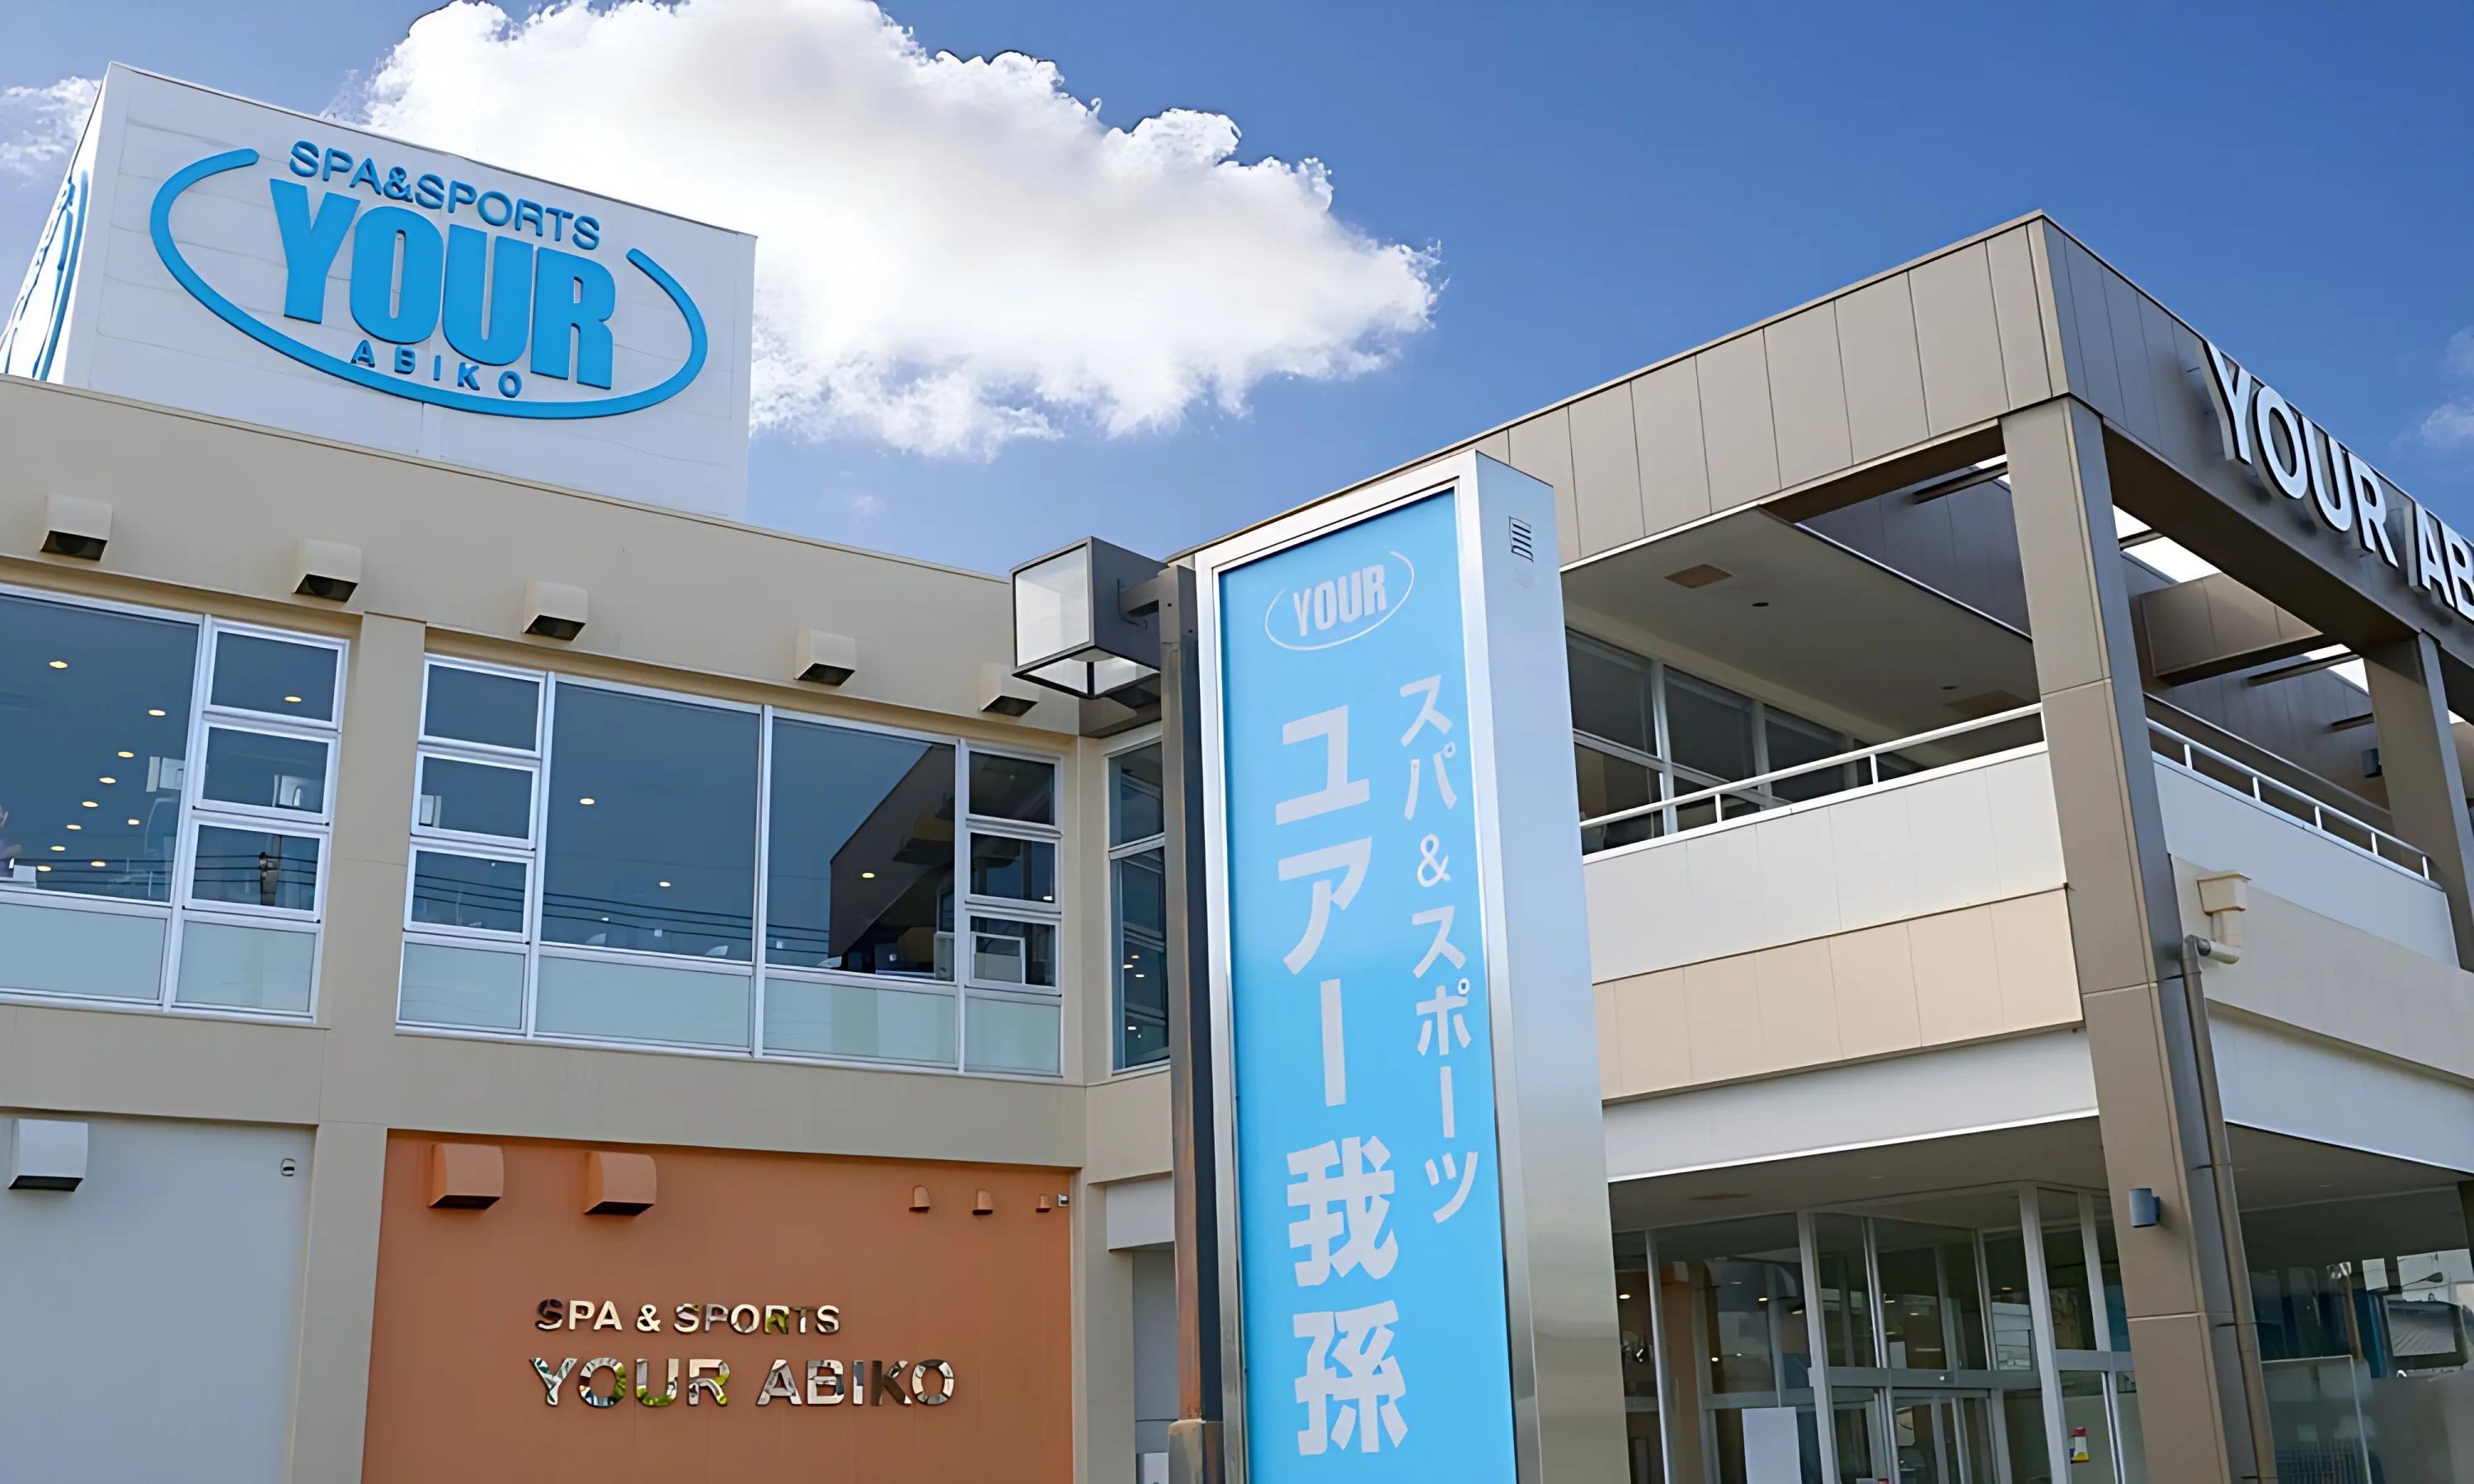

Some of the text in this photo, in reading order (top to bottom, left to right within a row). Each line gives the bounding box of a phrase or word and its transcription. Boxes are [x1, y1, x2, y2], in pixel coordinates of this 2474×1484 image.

[290, 140, 600, 249] SPA&SPORTS
[270, 177, 616, 390] YOUR
[350, 339, 524, 399] ABIKO
[2197, 340, 2399, 570] YOUR
[1292, 563, 1387, 637] YOUR
[535, 1298, 840, 1335] SPA & SPORTS
[529, 1356, 955, 1407] YOUR ABIKO
